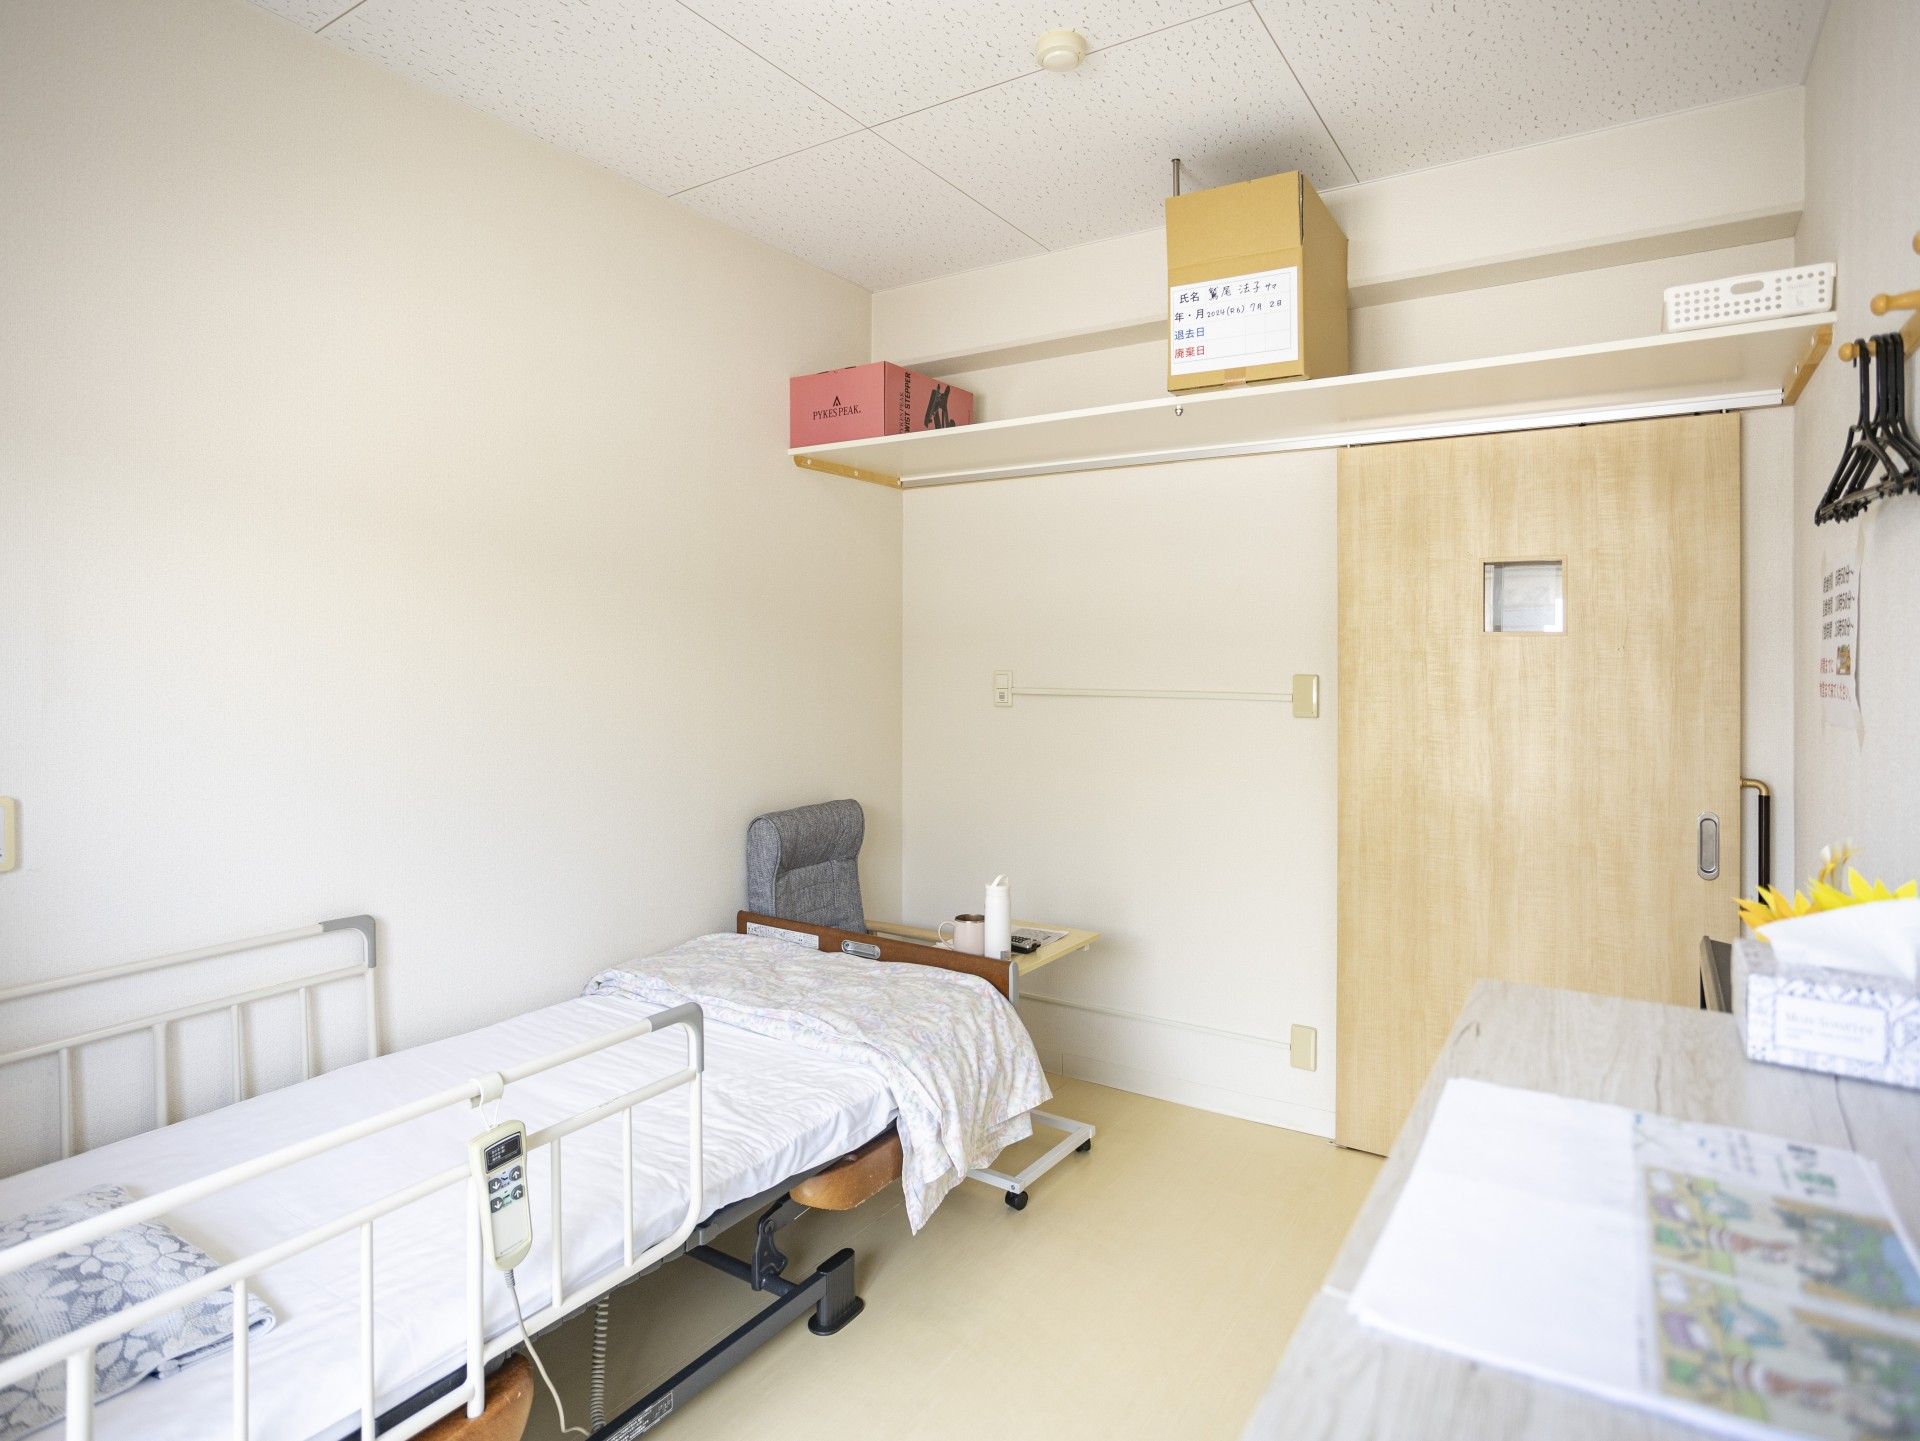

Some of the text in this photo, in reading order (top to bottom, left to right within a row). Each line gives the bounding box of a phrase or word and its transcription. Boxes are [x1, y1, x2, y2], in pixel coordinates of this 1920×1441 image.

[1179, 292, 1200, 304] 氏名
[1238, 281, 1260, 295] 法子
[1174, 308, 1205, 323] 年・月
[1174, 327, 1206, 341] 退去日
[1174, 346, 1206, 359] 廃棄日
